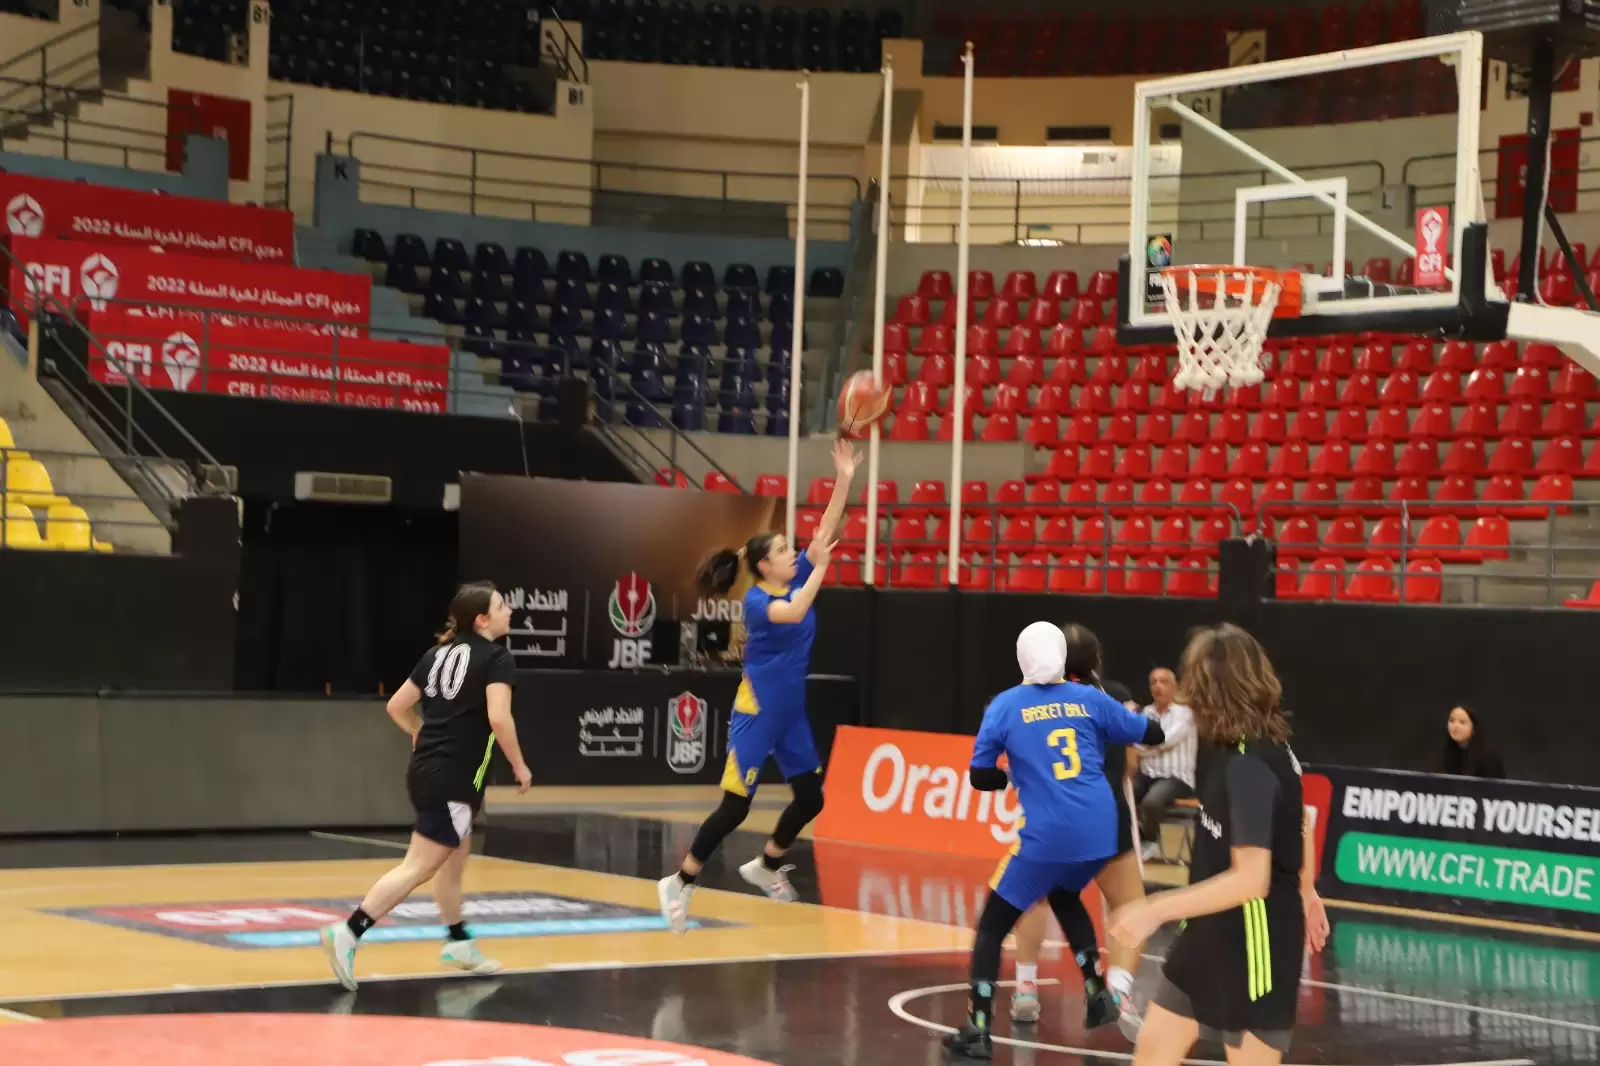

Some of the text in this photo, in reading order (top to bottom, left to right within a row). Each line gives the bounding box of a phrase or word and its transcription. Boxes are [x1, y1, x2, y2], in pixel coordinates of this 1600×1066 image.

[335, 161, 348, 181] K
[1382, 190, 1393, 210] L
[71, 215, 111, 236] 2022
[228, 236, 254, 254] CFI
[1419, 254, 1443, 273] CFI
[24, 262, 71, 298] CFI
[147, 275, 187, 295] 2022
[305, 293, 330, 309] CFI
[105, 341, 153, 377] CFI
[228, 352, 268, 373] 2022
[227, 381, 255, 398] CFI
[387, 371, 412, 389] CFI
[608, 638, 652, 669] JBF
[424, 642, 471, 700] 10
[1021, 702, 1091, 723] BASKET BALL
[671, 741, 704, 765] JBF
[1047, 727, 1082, 780] 3
[1342, 785, 1478, 830] EMPOWER
[1356, 843, 1595, 901] WWW.CFI.TRADE
